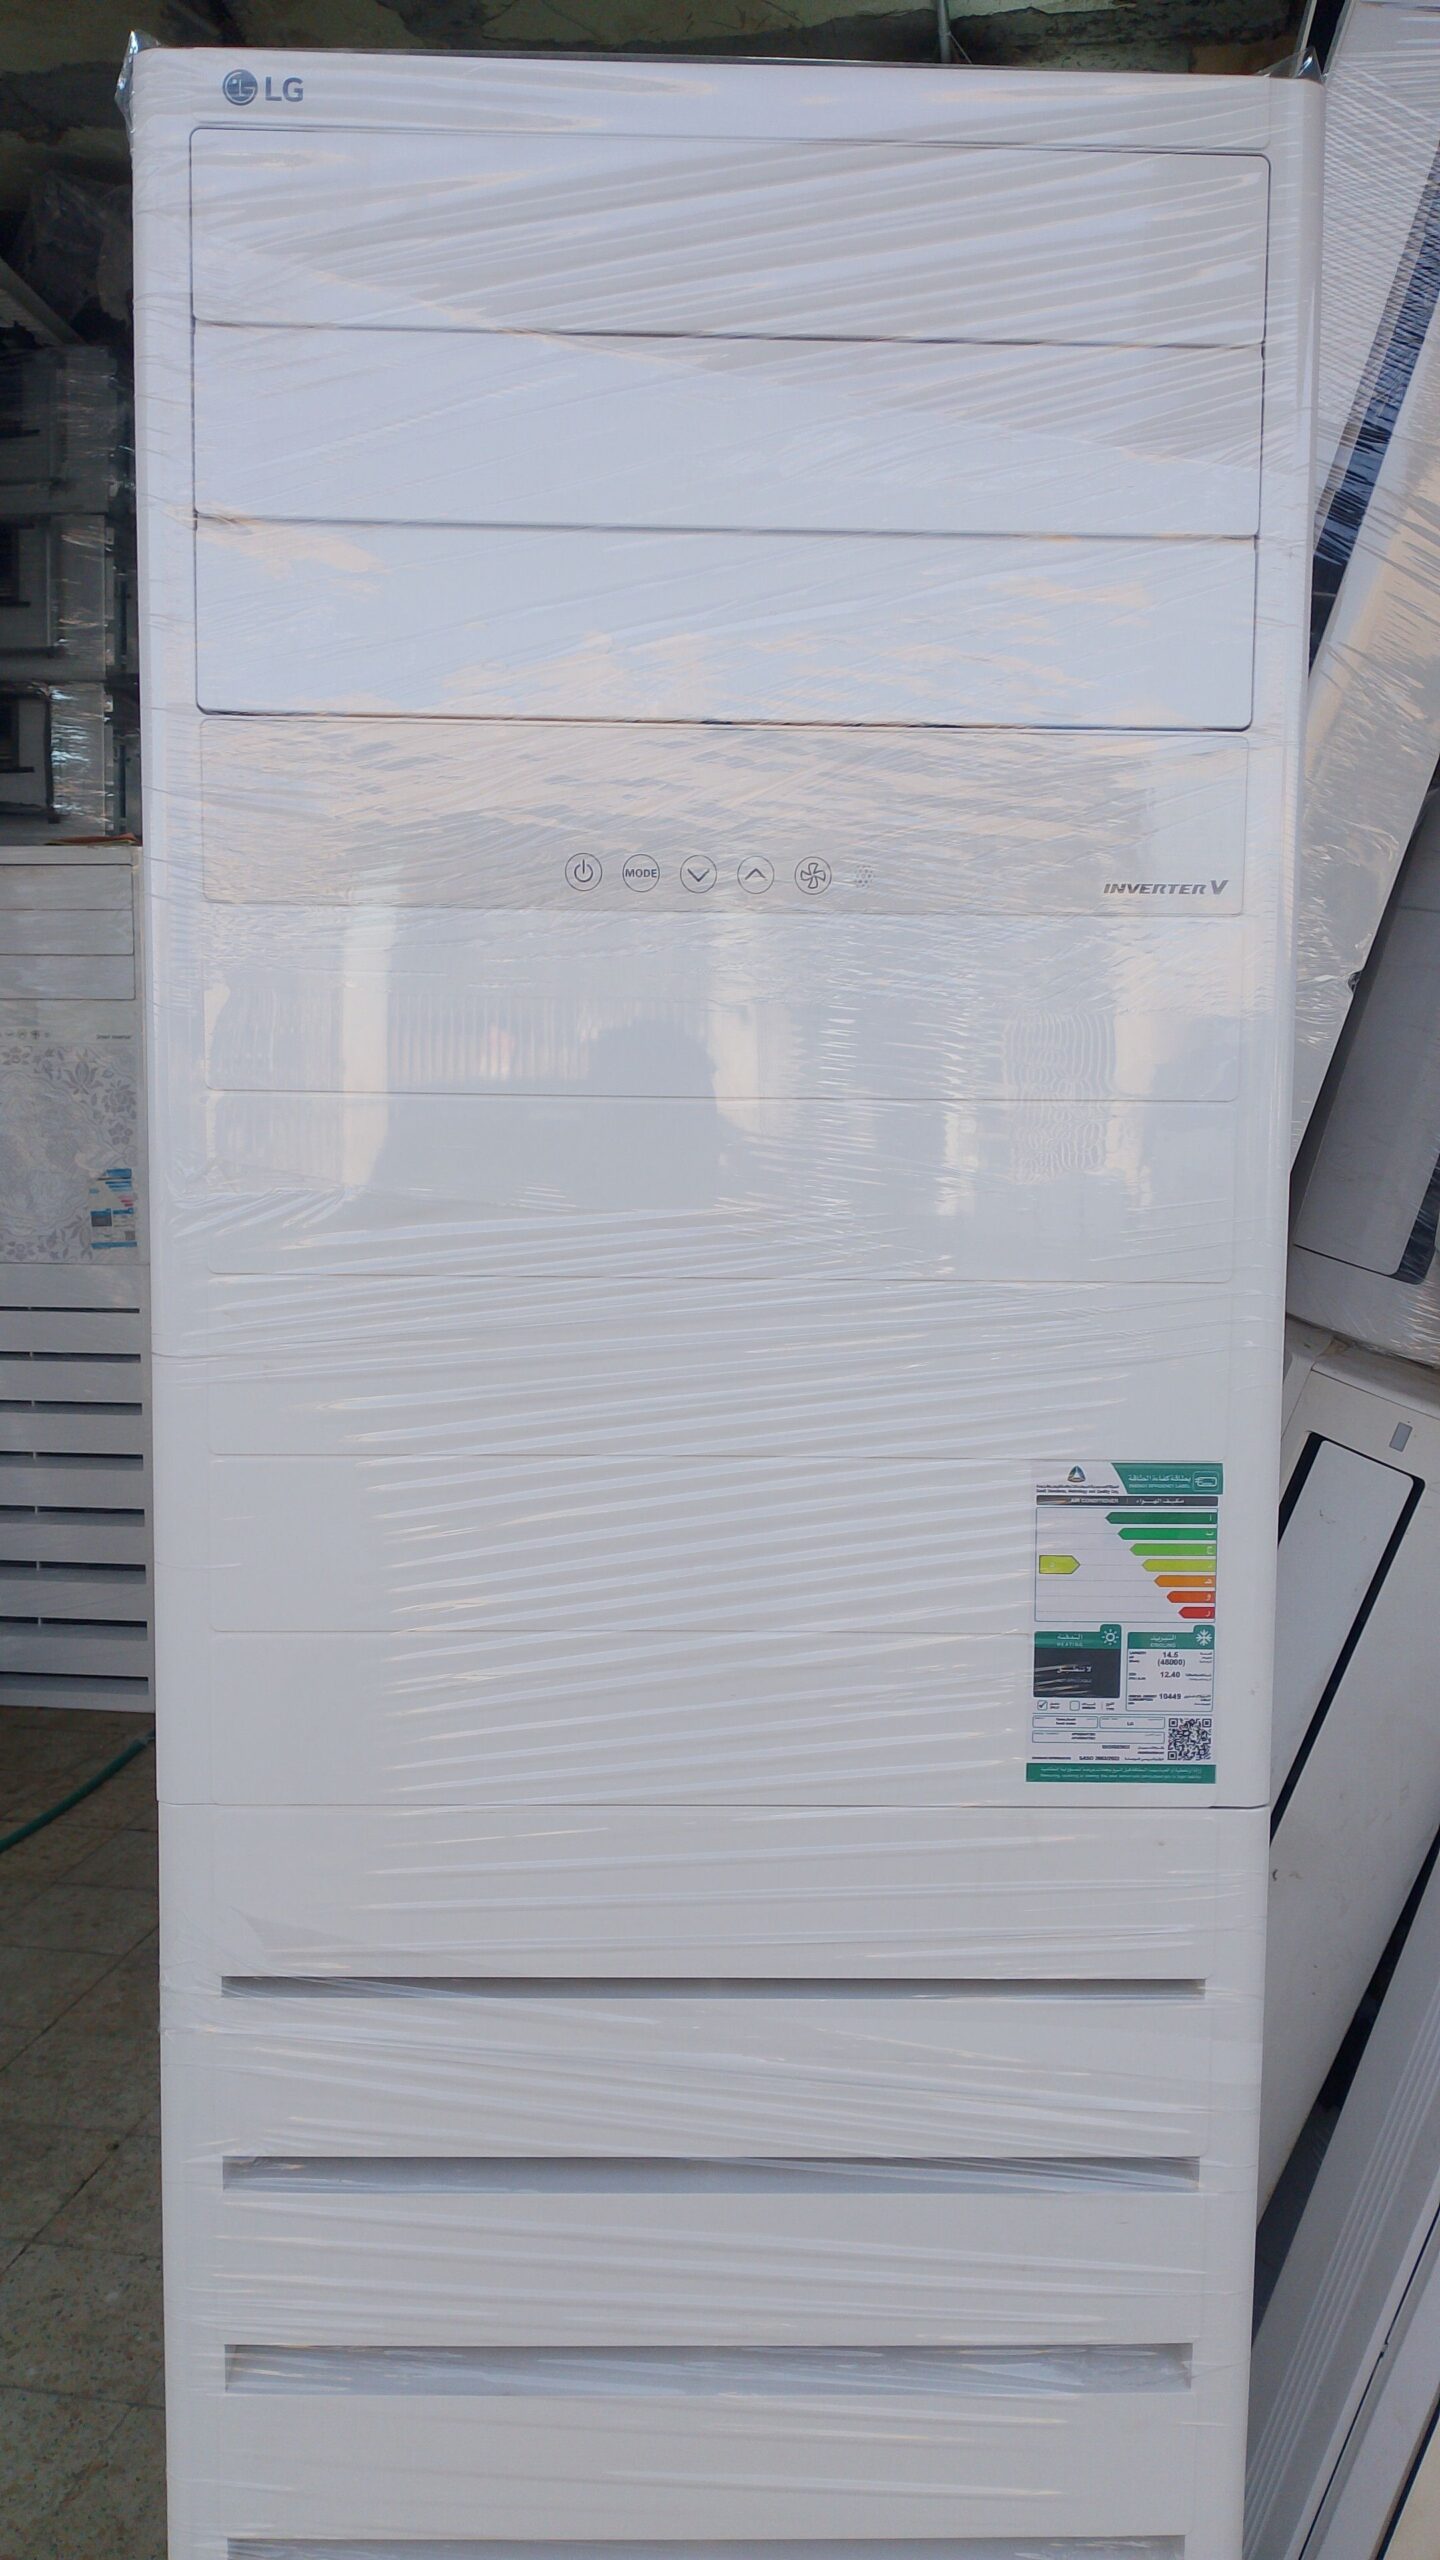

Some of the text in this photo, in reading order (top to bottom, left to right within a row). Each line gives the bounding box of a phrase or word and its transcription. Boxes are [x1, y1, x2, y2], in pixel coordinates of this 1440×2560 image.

[264, 76, 304, 102] LG
[625, 868, 657, 878] MODE
[1103, 880, 1229, 895] INVERTER V
